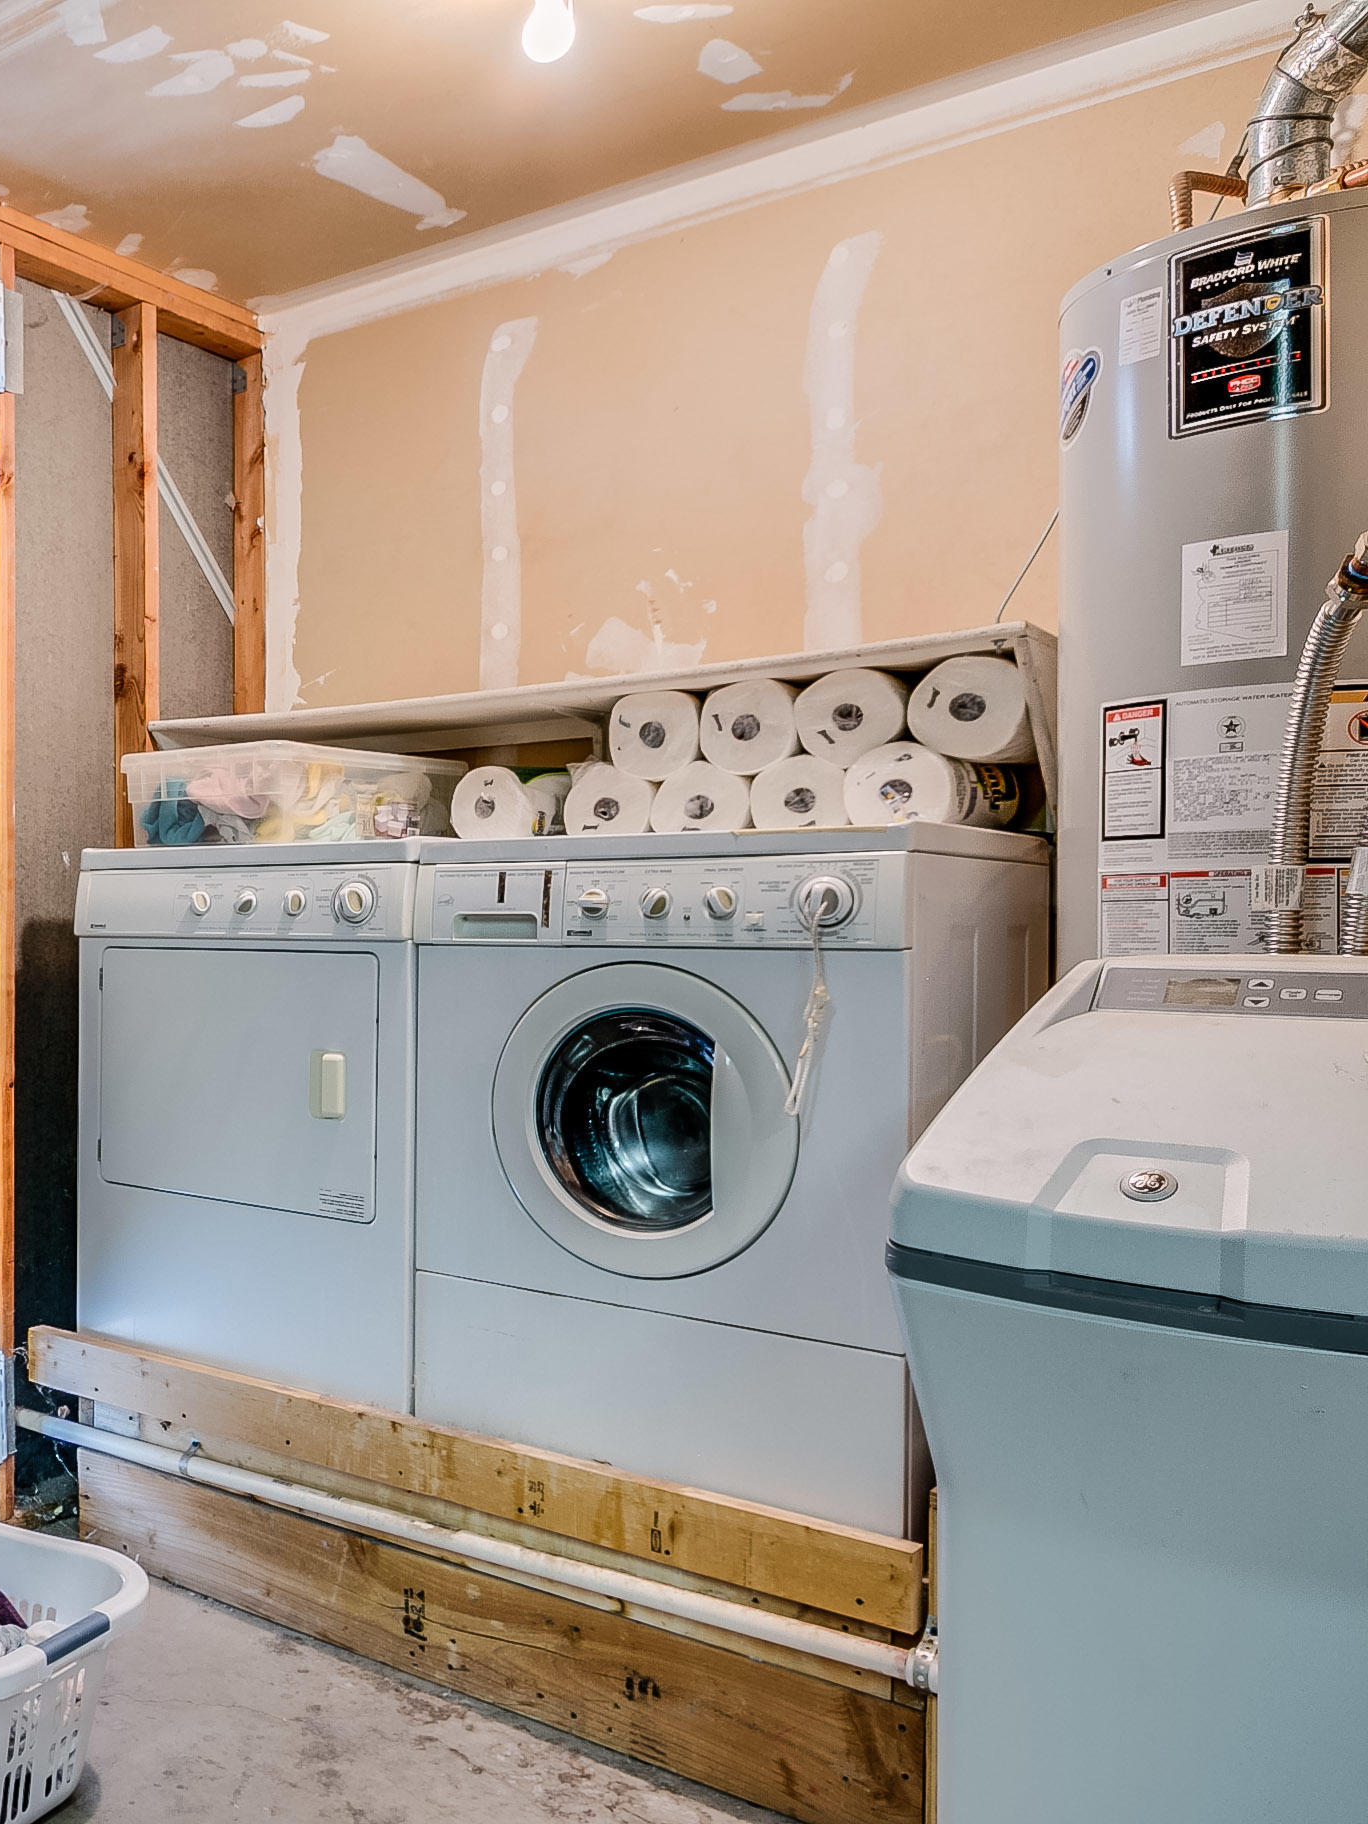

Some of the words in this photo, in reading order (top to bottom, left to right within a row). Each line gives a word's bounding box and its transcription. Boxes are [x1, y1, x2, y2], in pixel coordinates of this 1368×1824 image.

[1190, 264, 1254, 289] BRADFORD
[1257, 253, 1301, 270] WHITE
[1173, 286, 1323, 336] DEFENDER
[1191, 327, 1240, 348] SAFETY
[1210, 696, 1240, 704] STORAGE
[1121, 709, 1154, 720] DANGER
